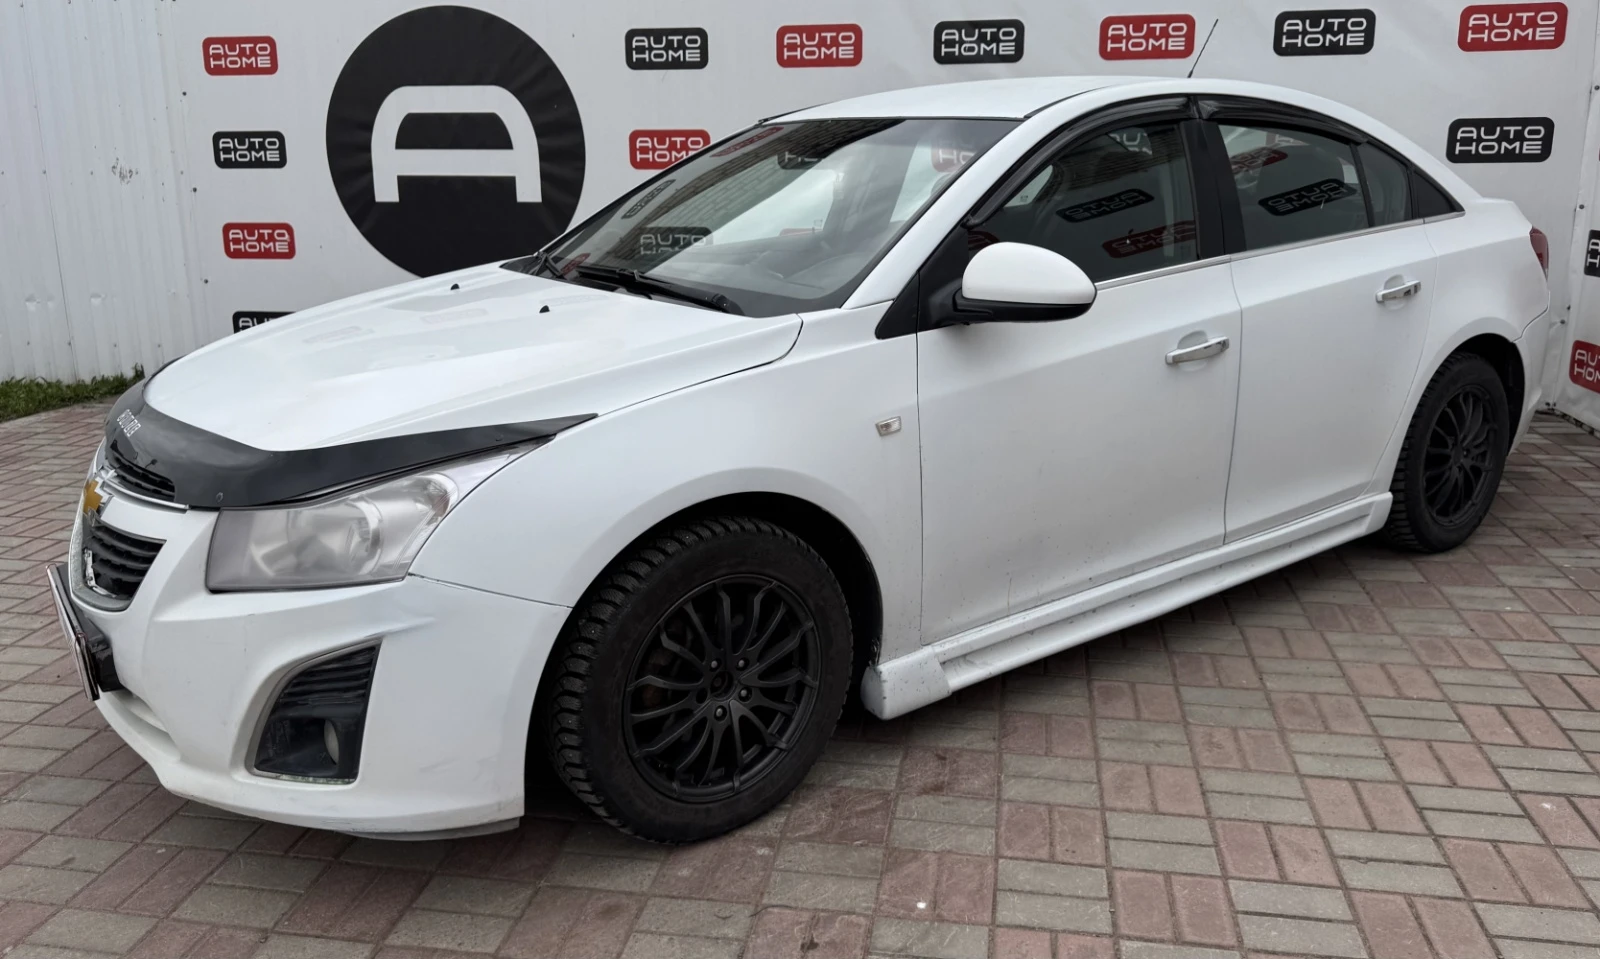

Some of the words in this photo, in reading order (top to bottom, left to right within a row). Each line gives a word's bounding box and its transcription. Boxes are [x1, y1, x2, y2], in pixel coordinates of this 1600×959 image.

[1283, 17, 1367, 33] AUTO
[1468, 11, 1558, 28] AUTO
[941, 27, 1017, 42] AUTO
[1107, 22, 1188, 37] AUTO
[1467, 27, 1556, 43] HOME
[632, 35, 701, 49] AUTO
[783, 32, 856, 46] AUTO
[1107, 37, 1186, 52] HOME
[1282, 32, 1365, 48] HOME
[209, 43, 271, 56] AUTO
[632, 49, 701, 62] HOME
[783, 46, 856, 60] HOME
[941, 42, 1016, 56] HOME
[210, 56, 271, 69] HOME
[1456, 126, 1545, 140] AUTO
[219, 138, 280, 149] AUTO
[370, 85, 543, 203] A
[636, 137, 704, 149] AUTO
[1455, 141, 1543, 155] HOME
[220, 150, 280, 162] HOME
[636, 150, 697, 163] HOM
[229, 229, 289, 240] AUTO
[230, 241, 289, 252] HOME
